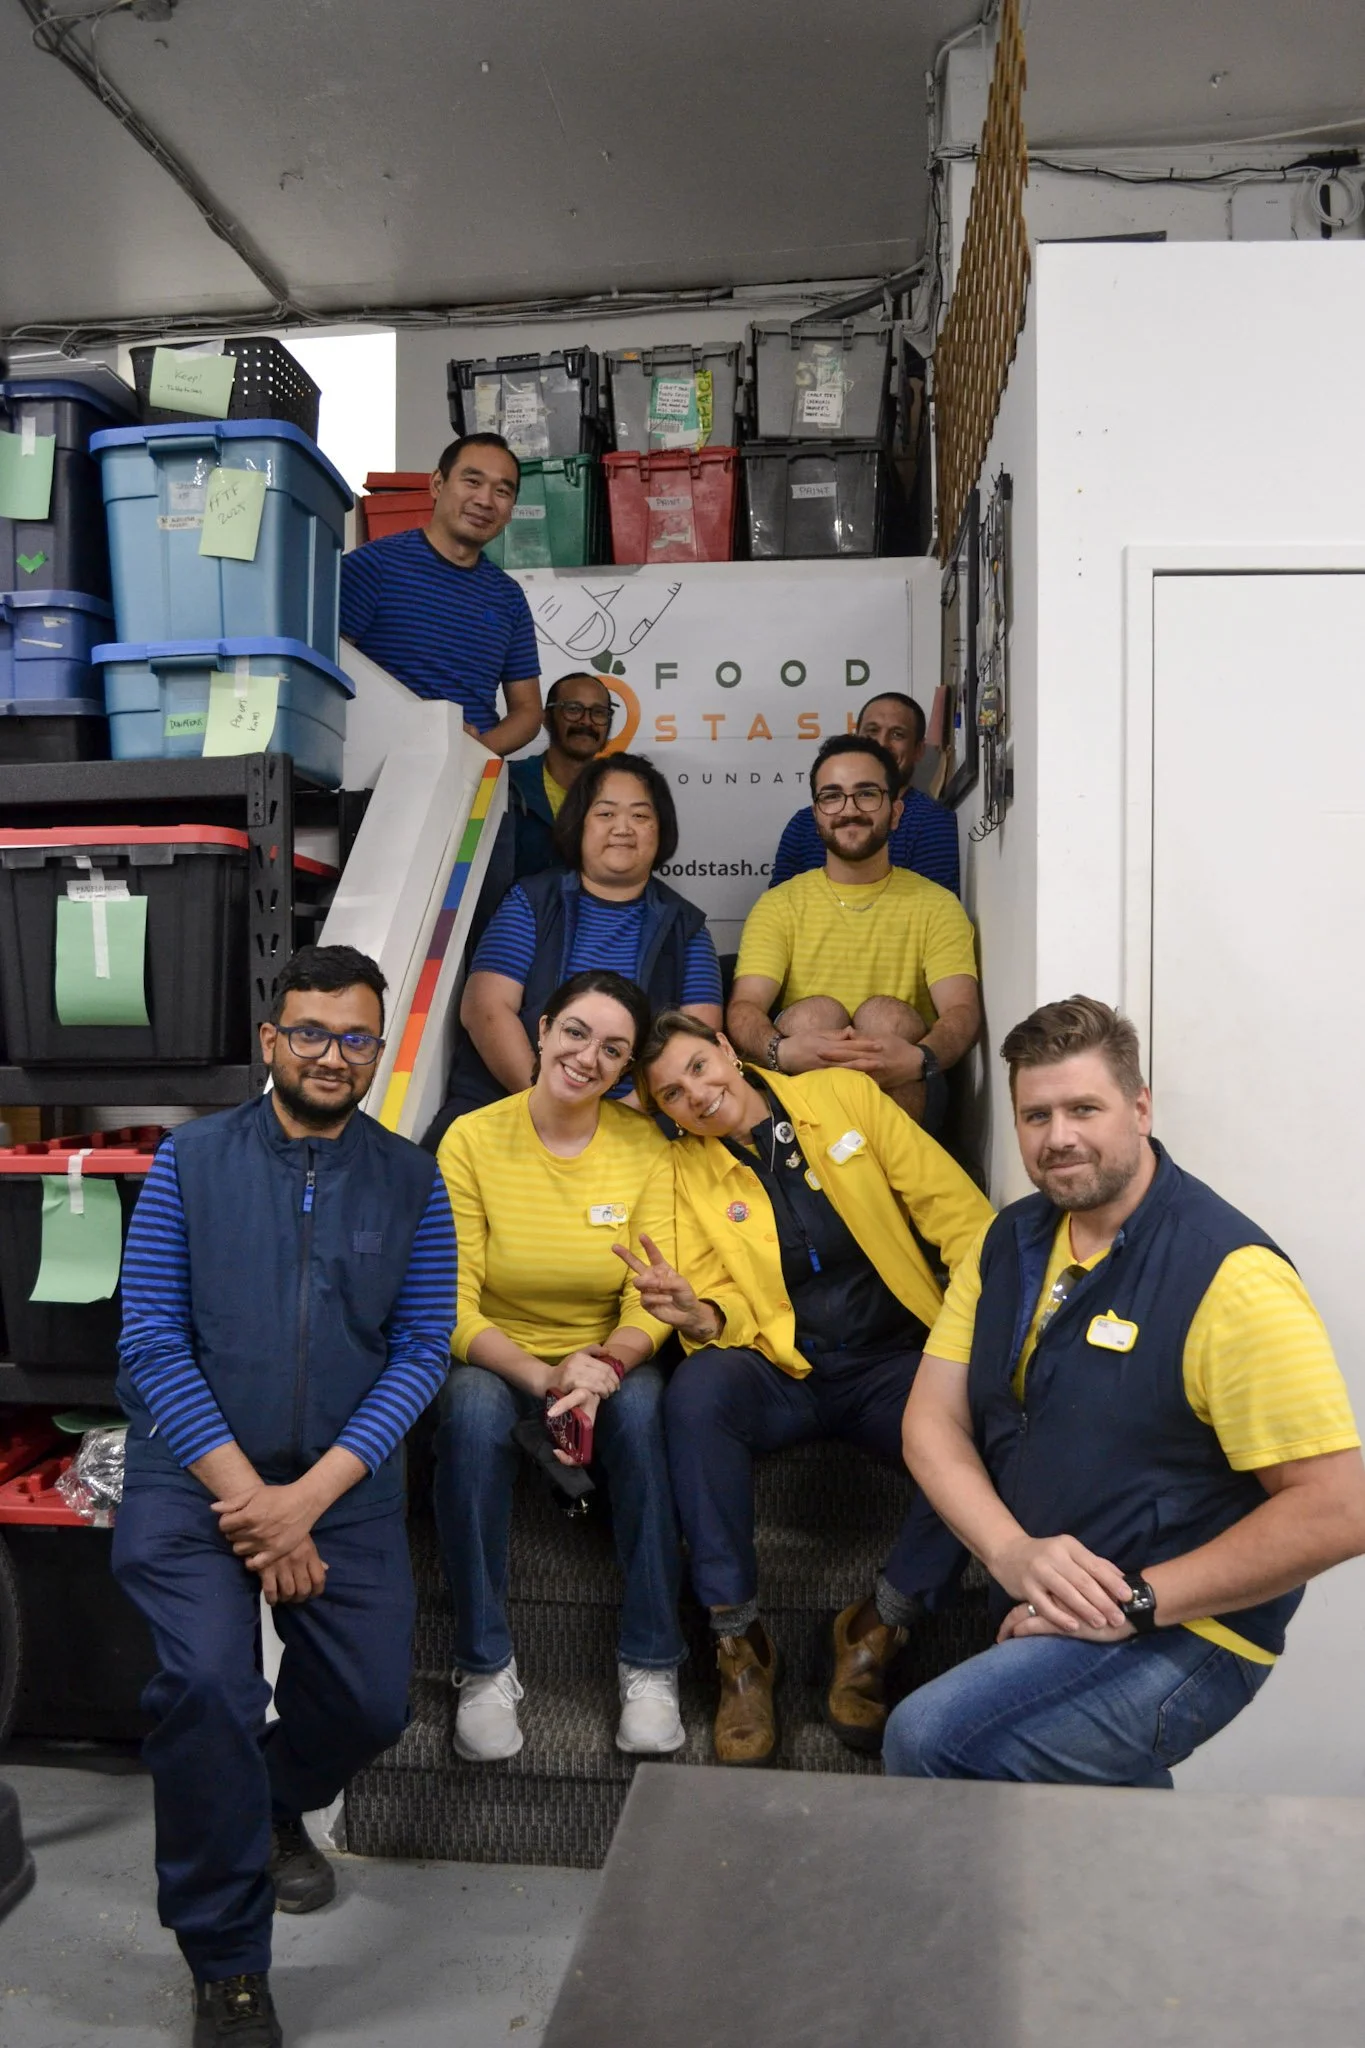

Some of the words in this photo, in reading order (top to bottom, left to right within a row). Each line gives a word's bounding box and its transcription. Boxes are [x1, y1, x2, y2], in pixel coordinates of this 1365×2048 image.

[800, 486, 829, 497] PAINT
[656, 498, 681, 507] PAINT
[513, 508, 541, 517] PAINT
[655, 659, 870, 689] FOOD
[677, 772, 805, 785] OUNDAT
[660, 859, 775, 877] oodstash.c
